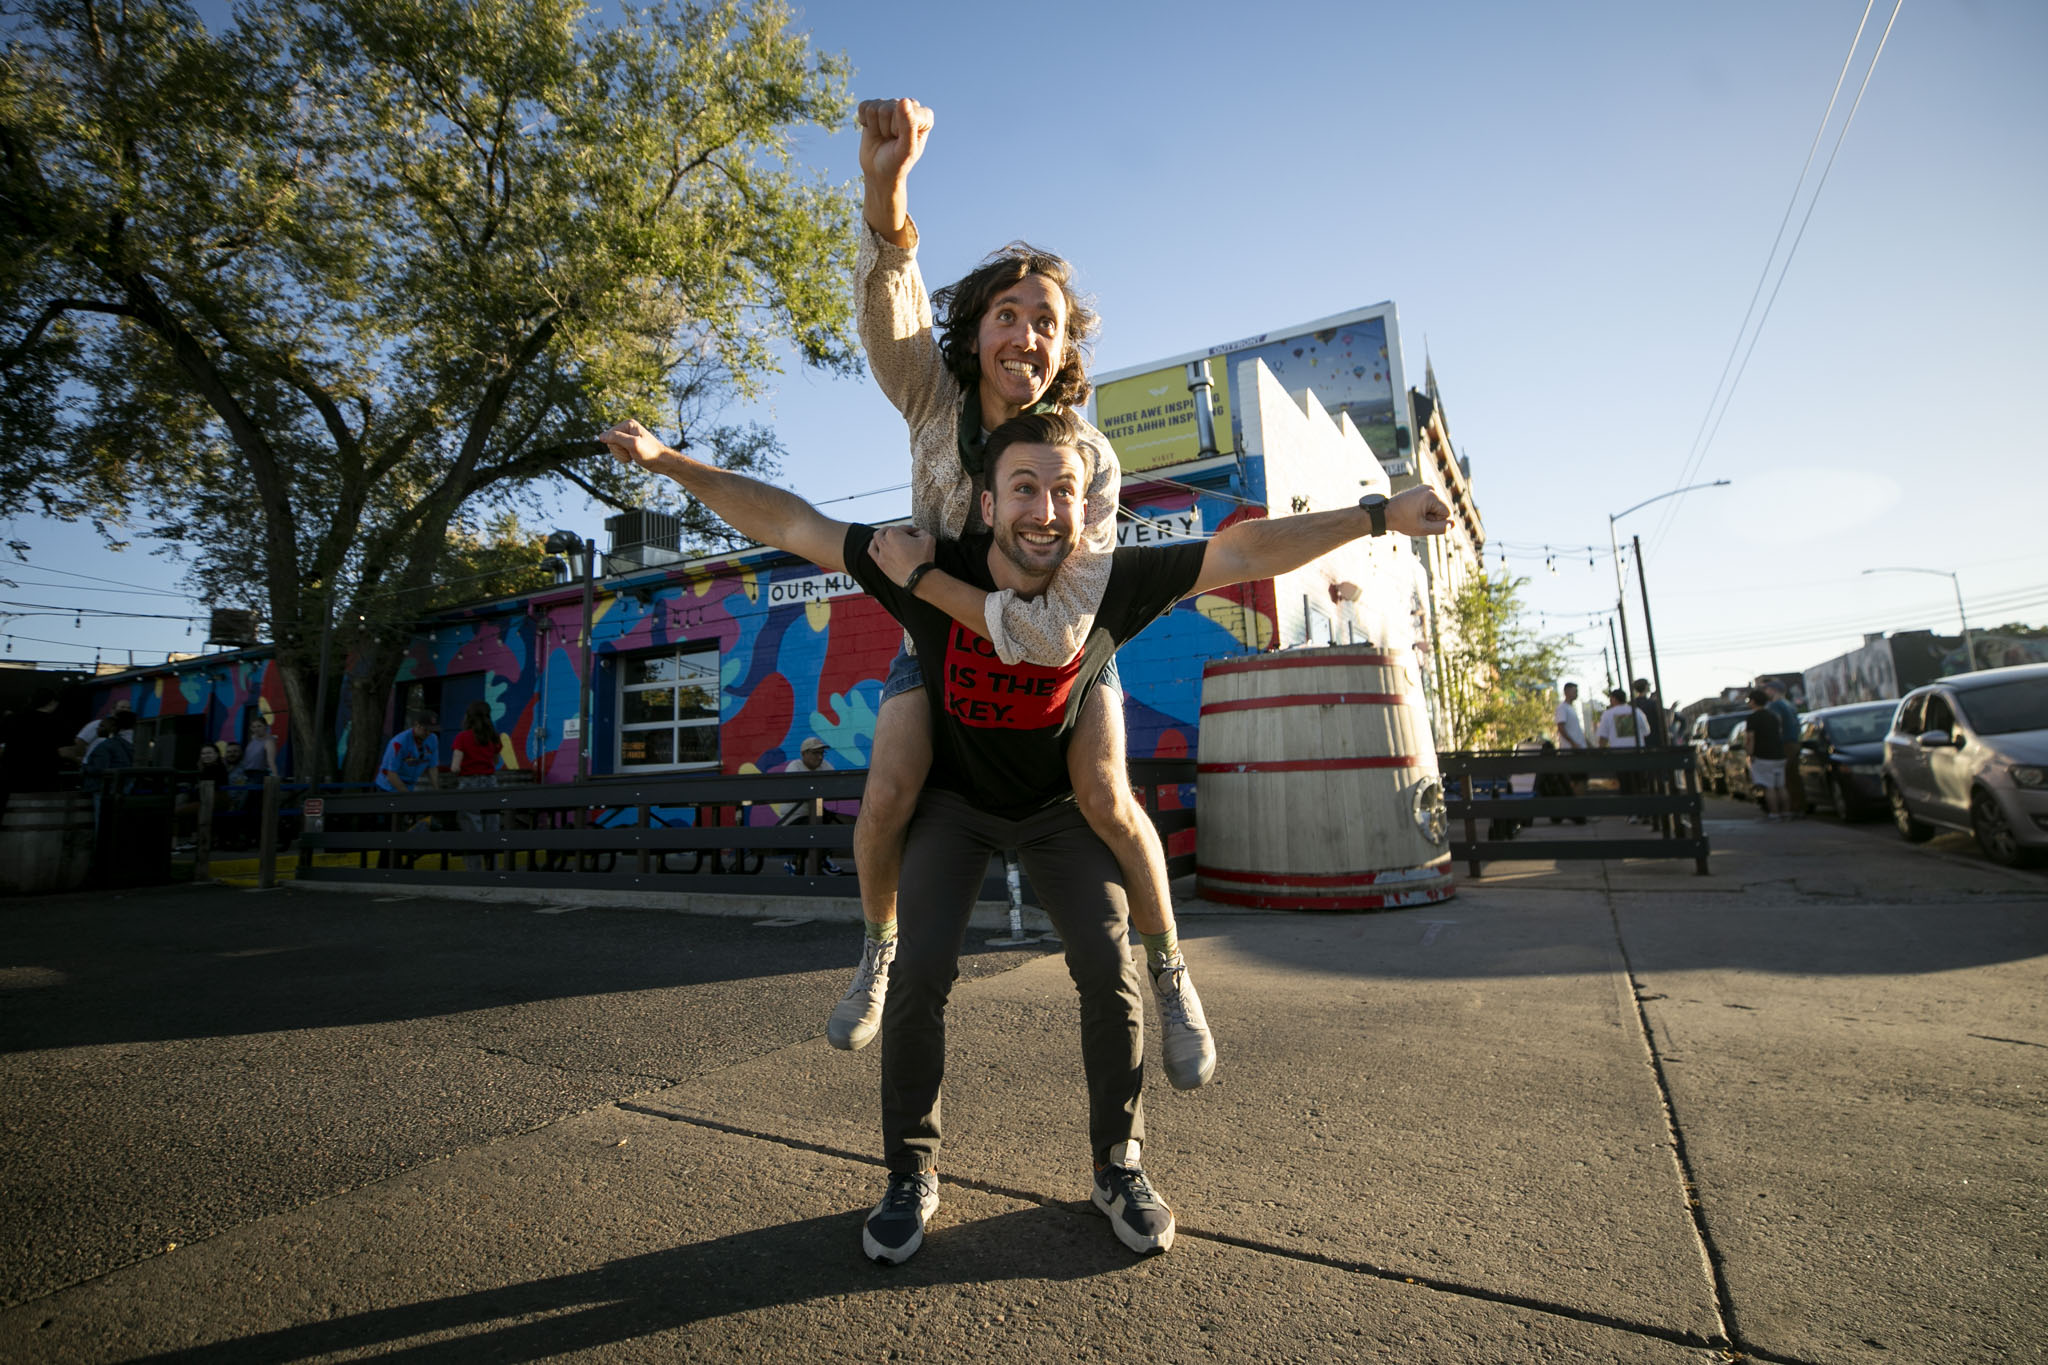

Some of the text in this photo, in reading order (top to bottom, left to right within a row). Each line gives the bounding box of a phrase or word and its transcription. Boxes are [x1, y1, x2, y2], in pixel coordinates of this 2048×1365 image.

[1104, 393, 1220, 427] WHERE AWE INSPIG
[1103, 425, 1135, 439] MEETS
[1137, 418, 1166, 432] AHHH
[771, 575, 855, 601] OUR MU
[955, 627, 998, 658] LO
[950, 664, 1056, 696] IS THE
[950, 691, 1015, 722] KEY.
